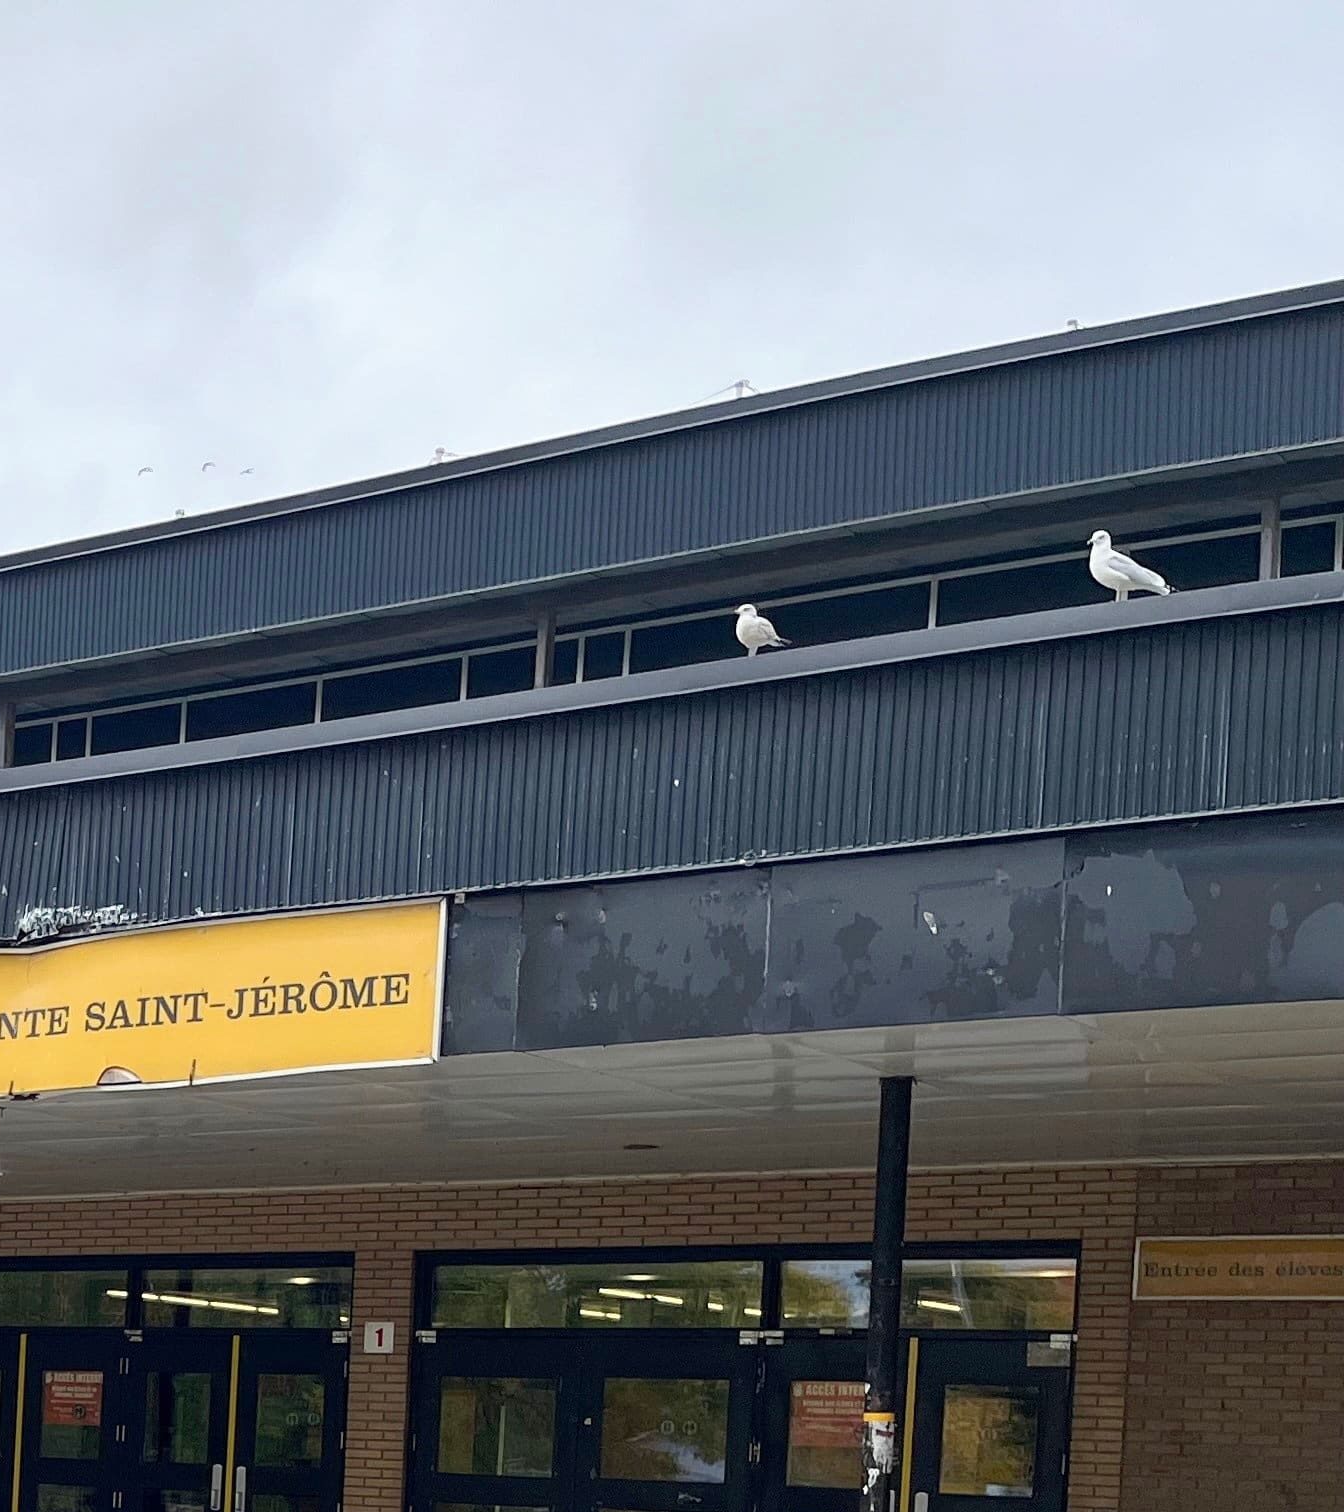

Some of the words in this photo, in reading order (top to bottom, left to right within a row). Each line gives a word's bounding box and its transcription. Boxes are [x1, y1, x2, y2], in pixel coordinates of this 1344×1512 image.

[84, 970, 411, 1033] SAINT-JÉRÔME
[1143, 1261, 1219, 1278] Entrée
[1228, 1261, 1266, 1278] des
[375, 1327, 384, 1348] 1
